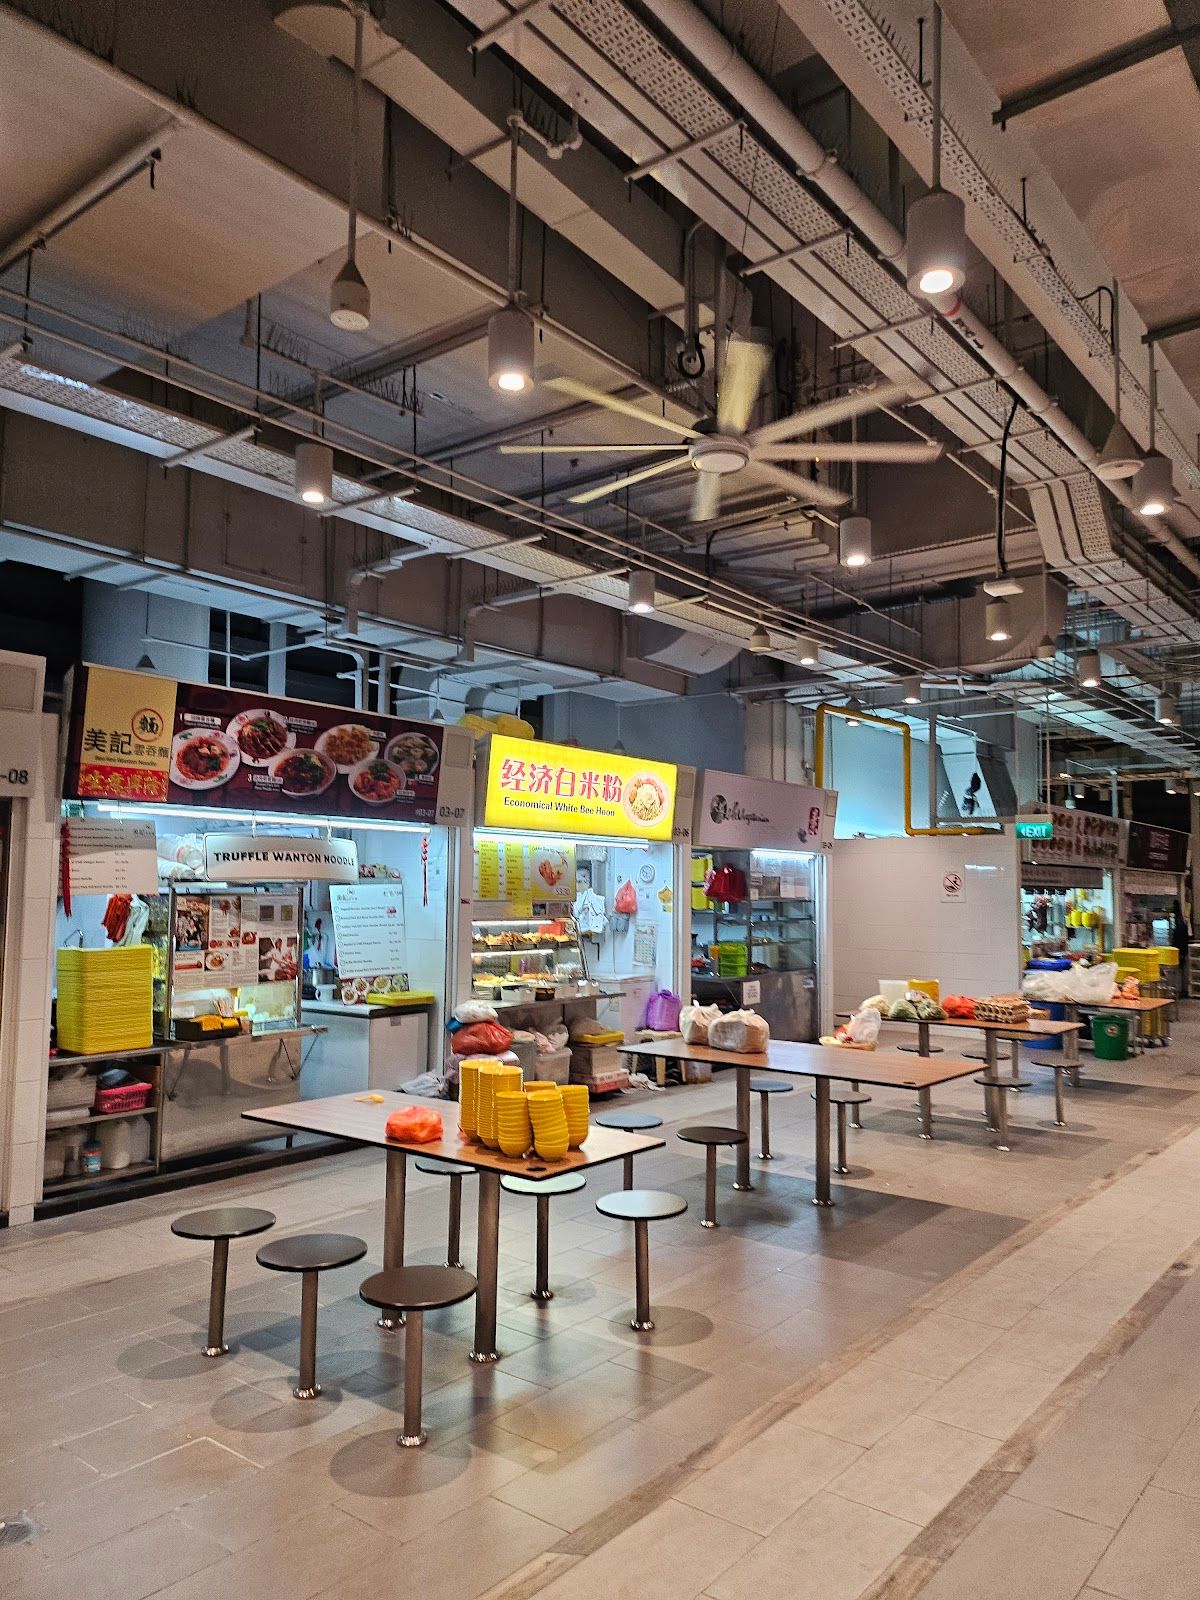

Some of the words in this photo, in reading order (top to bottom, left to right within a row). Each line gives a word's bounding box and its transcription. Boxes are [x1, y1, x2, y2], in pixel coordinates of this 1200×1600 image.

[84, 728, 132, 755] 美記
[501, 758, 623, 803] 经济白米粉
[440, 806, 465, 818] 03-07
[504, 797, 553, 810] Economical
[555, 802, 578, 813] White
[580, 805, 594, 814] Bee
[596, 806, 615, 816] Hoon
[1026, 825, 1047, 838] EXIT
[213, 851, 269, 862] TRUFFLE
[272, 851, 321, 863] WANTON
[324, 854, 355, 867] NOODLE
